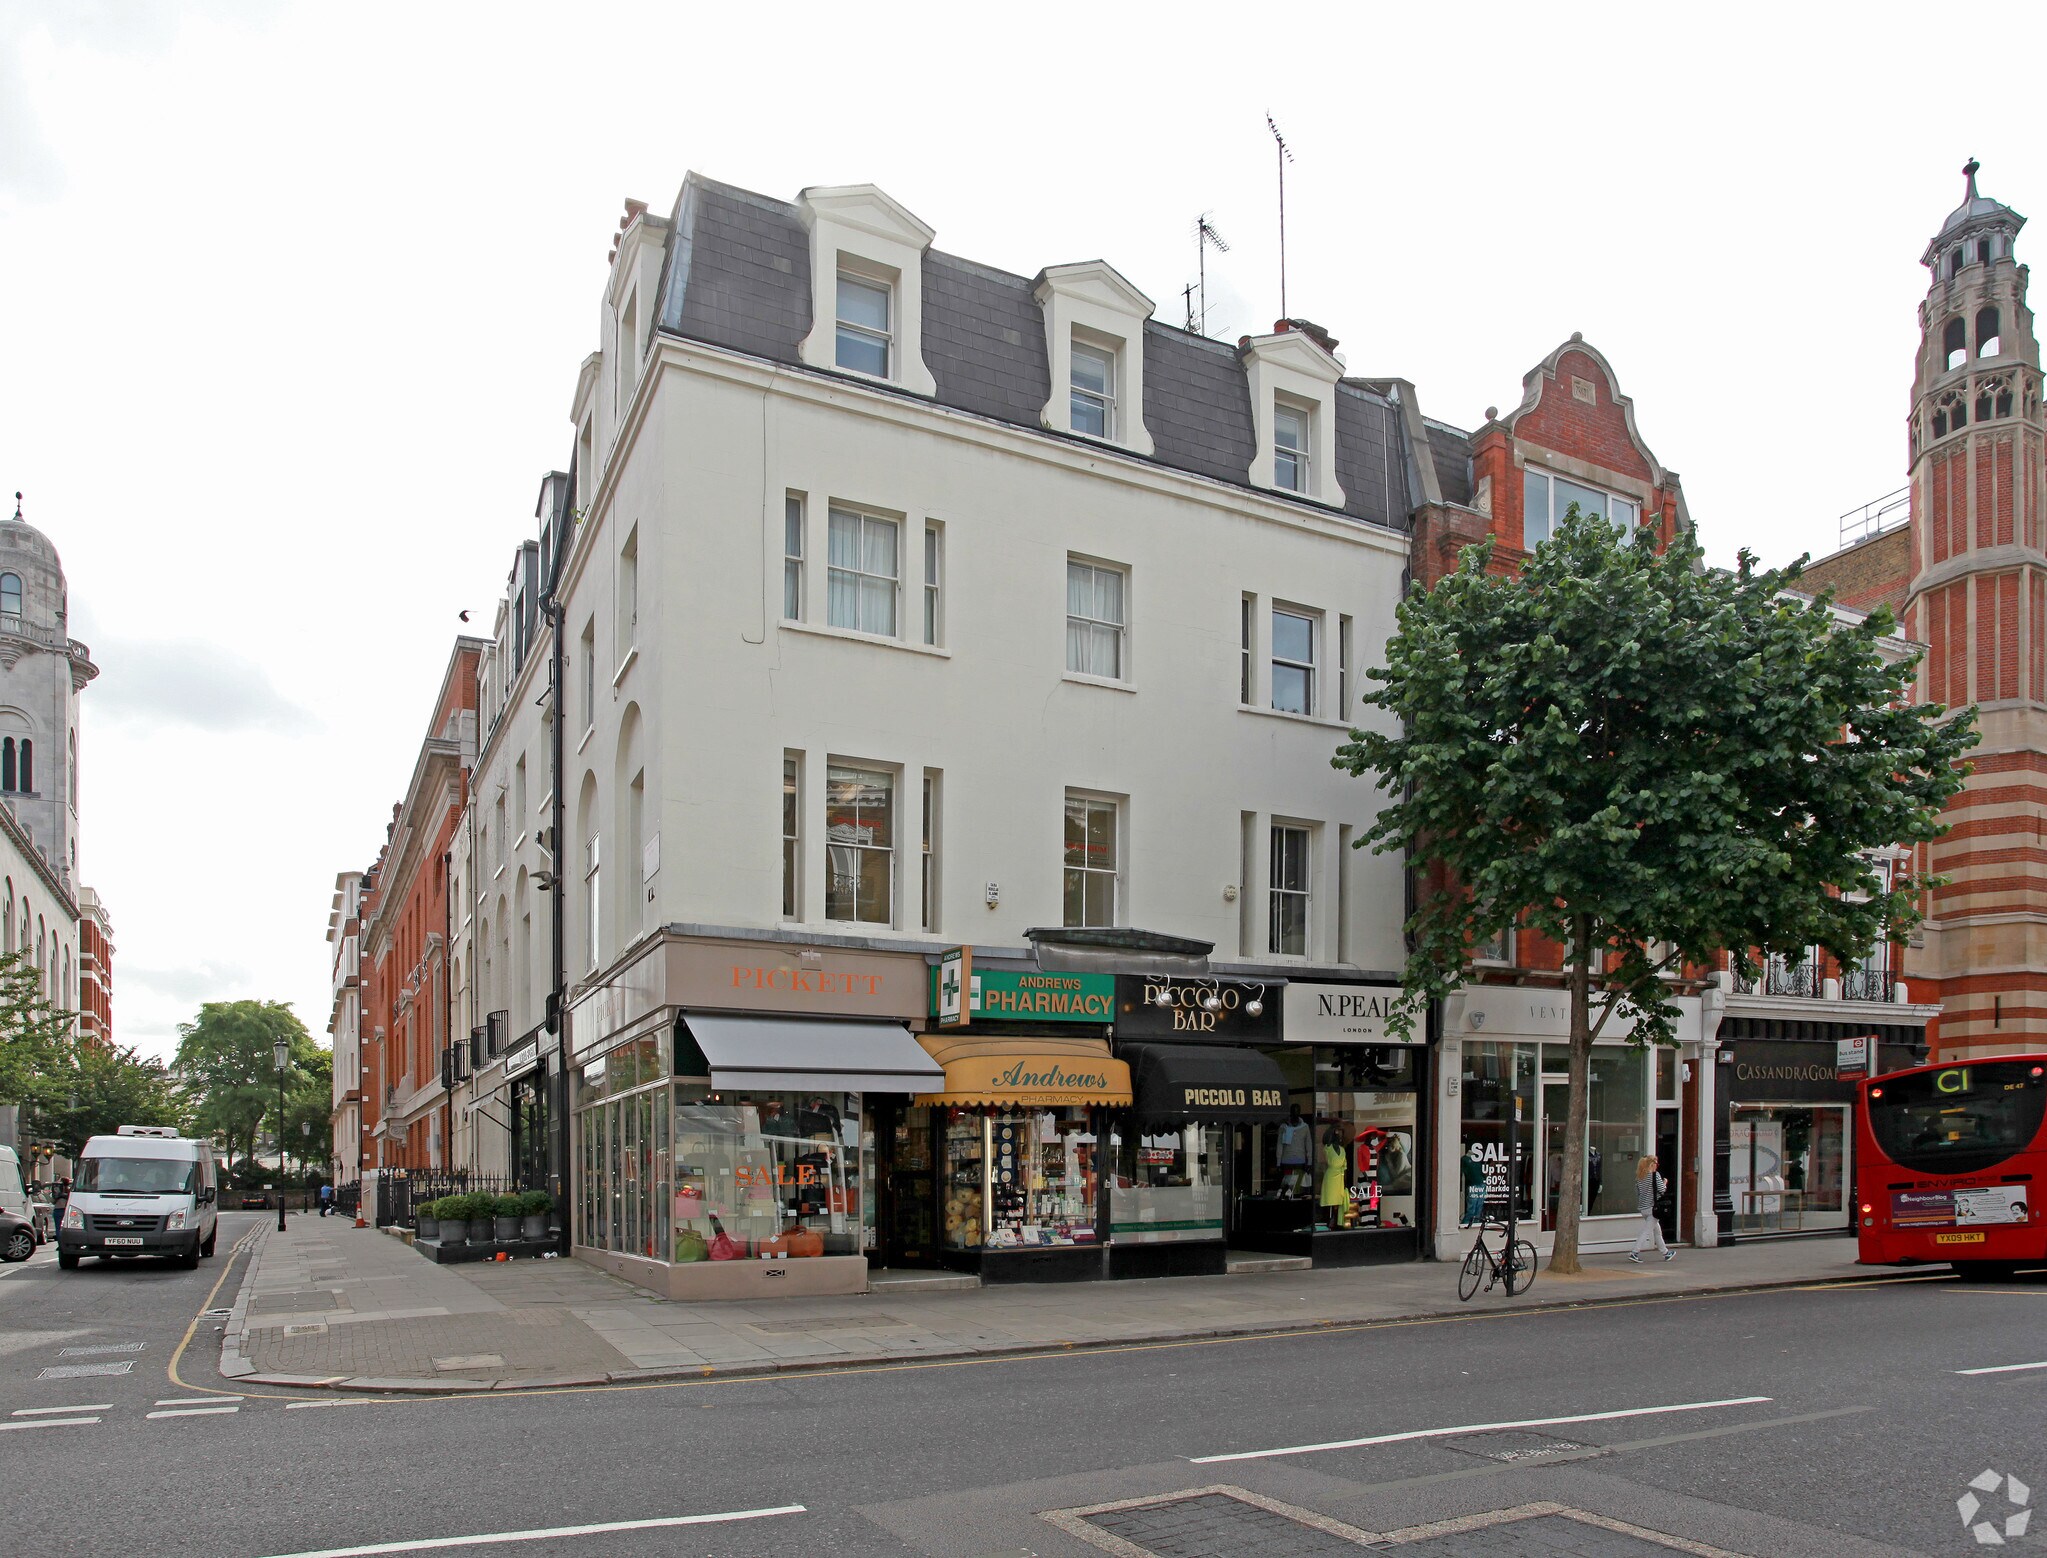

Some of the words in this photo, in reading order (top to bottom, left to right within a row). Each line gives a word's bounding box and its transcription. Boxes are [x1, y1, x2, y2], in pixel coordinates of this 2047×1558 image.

[943, 951, 961, 962] ANDREWS
[730, 967, 883, 995] PICKETT
[1018, 976, 1082, 990] ANDREWS
[985, 989, 1113, 1015] PHARMACY
[940, 1015, 960, 1024] PHARMACY
[1172, 1009, 1216, 1032] BAR
[991, 1060, 1108, 1089] Andrews
[1021, 1095, 1084, 1103] PHARMACY
[1184, 1088, 1246, 1106] PICCOLO
[1252, 1089, 1282, 1106] BAR
[735, 1164, 816, 1188] SALE
[1481, 1164, 1495, 1176] Up
[1495, 1163, 1507, 1174] To
[1483, 1175, 1506, 1186] -60%
[1918, 1178, 1976, 1188] ENVIRO
[1350, 1185, 1383, 1199] SALE
[1469, 1185, 1485, 1193] New
[1939, 1234, 1963, 1242] YX09
[1964, 1233, 1981, 1241] HKT
